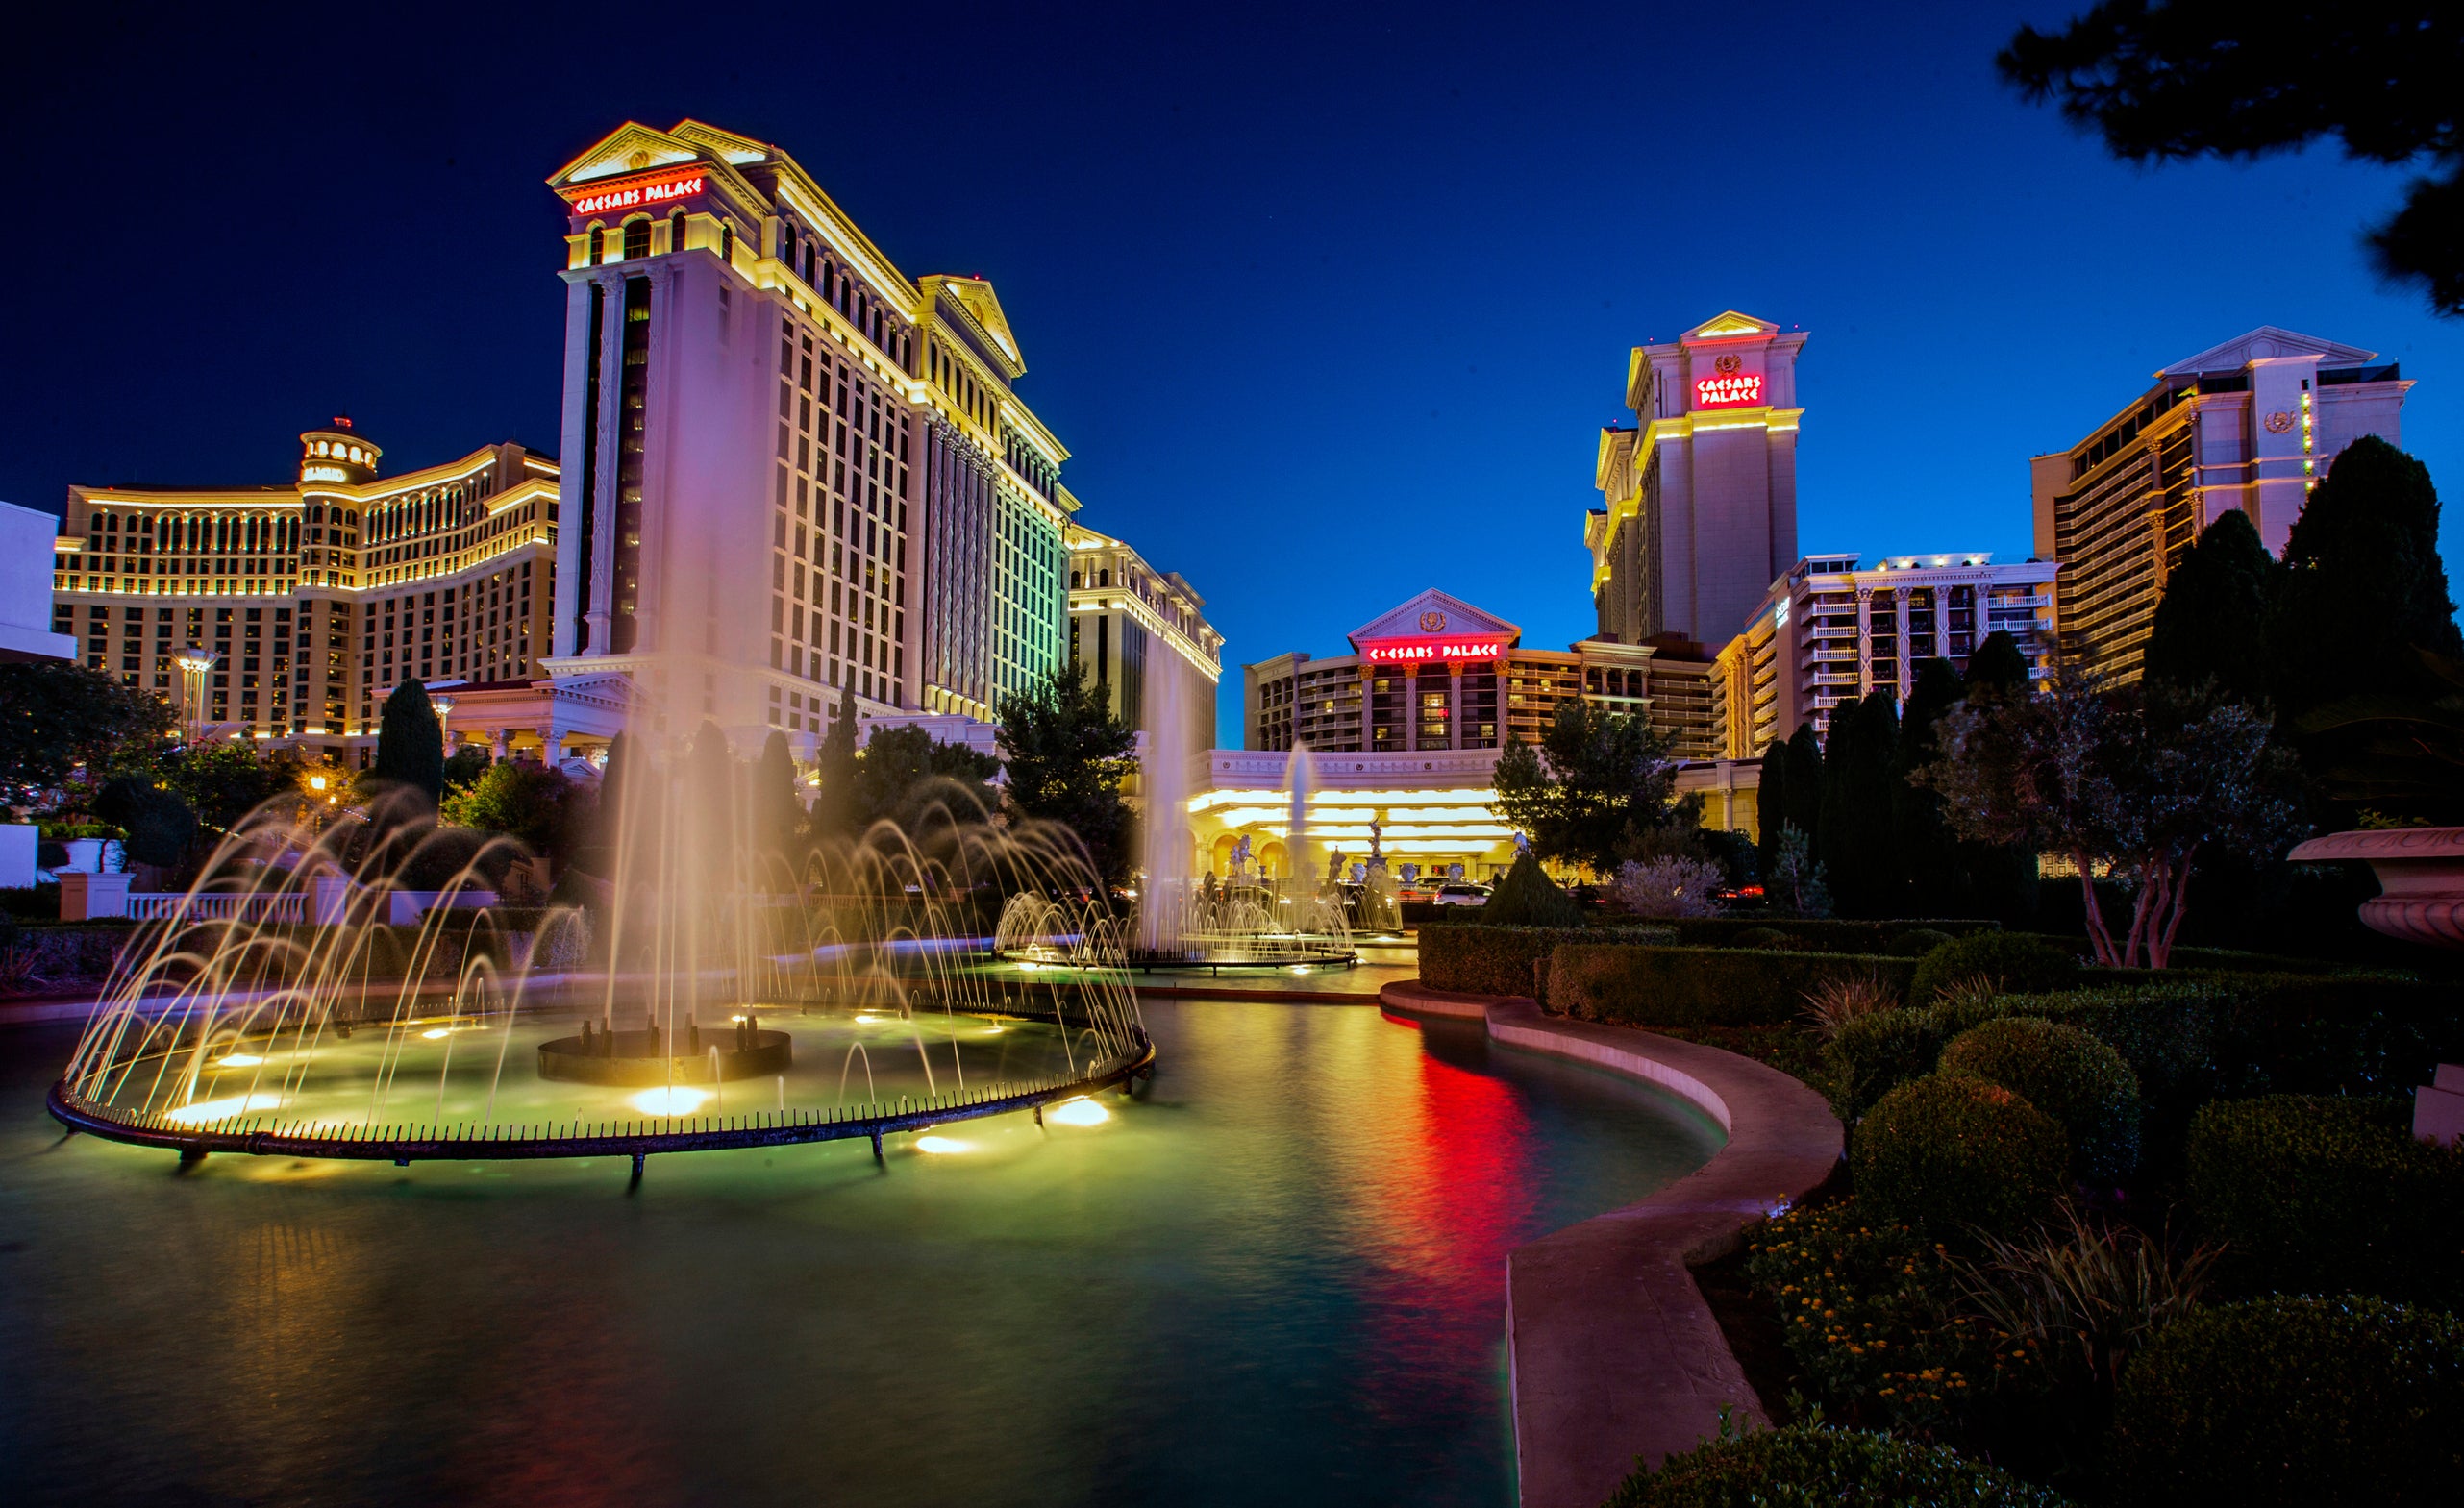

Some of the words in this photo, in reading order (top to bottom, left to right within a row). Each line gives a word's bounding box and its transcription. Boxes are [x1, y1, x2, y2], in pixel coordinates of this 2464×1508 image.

[576, 189, 641, 213] CAESARS
[645, 178, 702, 202] PALACE
[1697, 376, 1762, 392] CAESARS
[1701, 388, 1758, 405] PALACE
[1369, 646, 1434, 660] CAESARS
[1442, 643, 1499, 657] PALACE
